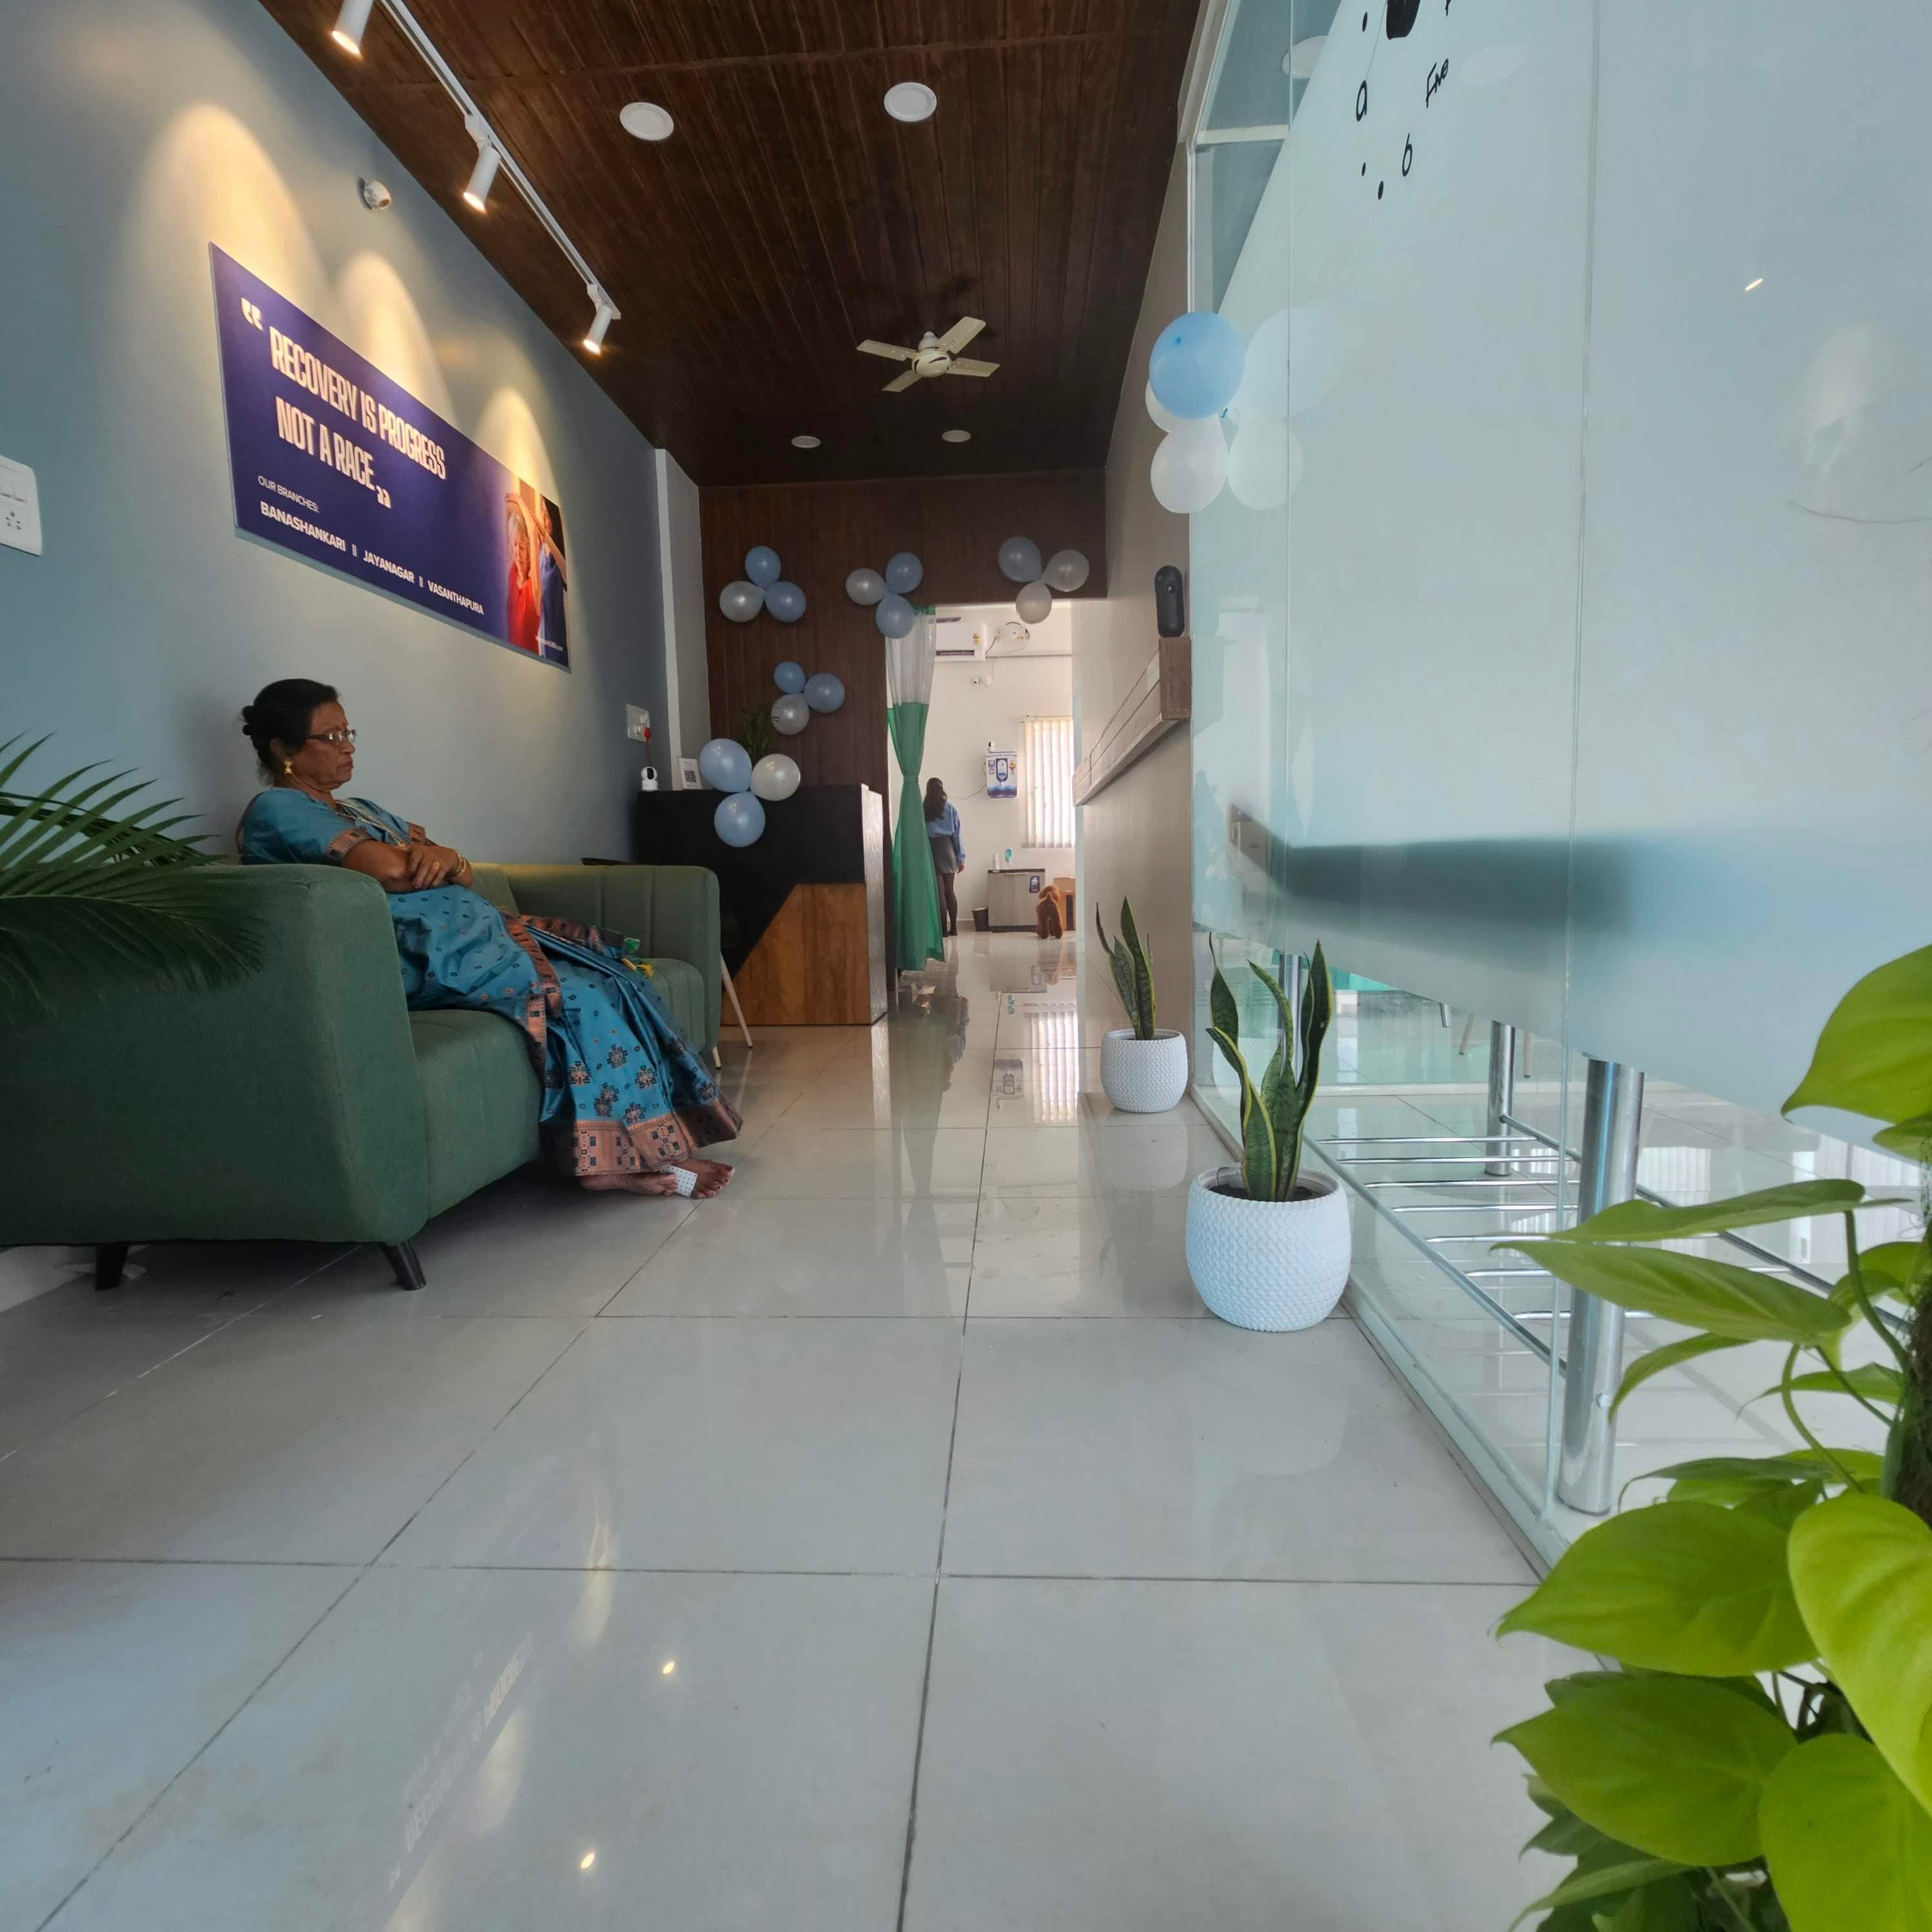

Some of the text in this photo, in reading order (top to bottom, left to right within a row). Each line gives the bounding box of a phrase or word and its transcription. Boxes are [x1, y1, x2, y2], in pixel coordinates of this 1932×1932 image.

[269, 325, 447, 480] RECOVERY IS PROGRESS
[275, 395, 315, 456] NOT
[319, 423, 333, 467] A
[258, 475, 320, 513] OUR BRANCHES:
[260, 500, 484, 615] BANASHANKARI JAYANAGAR VASANTHAPURA
